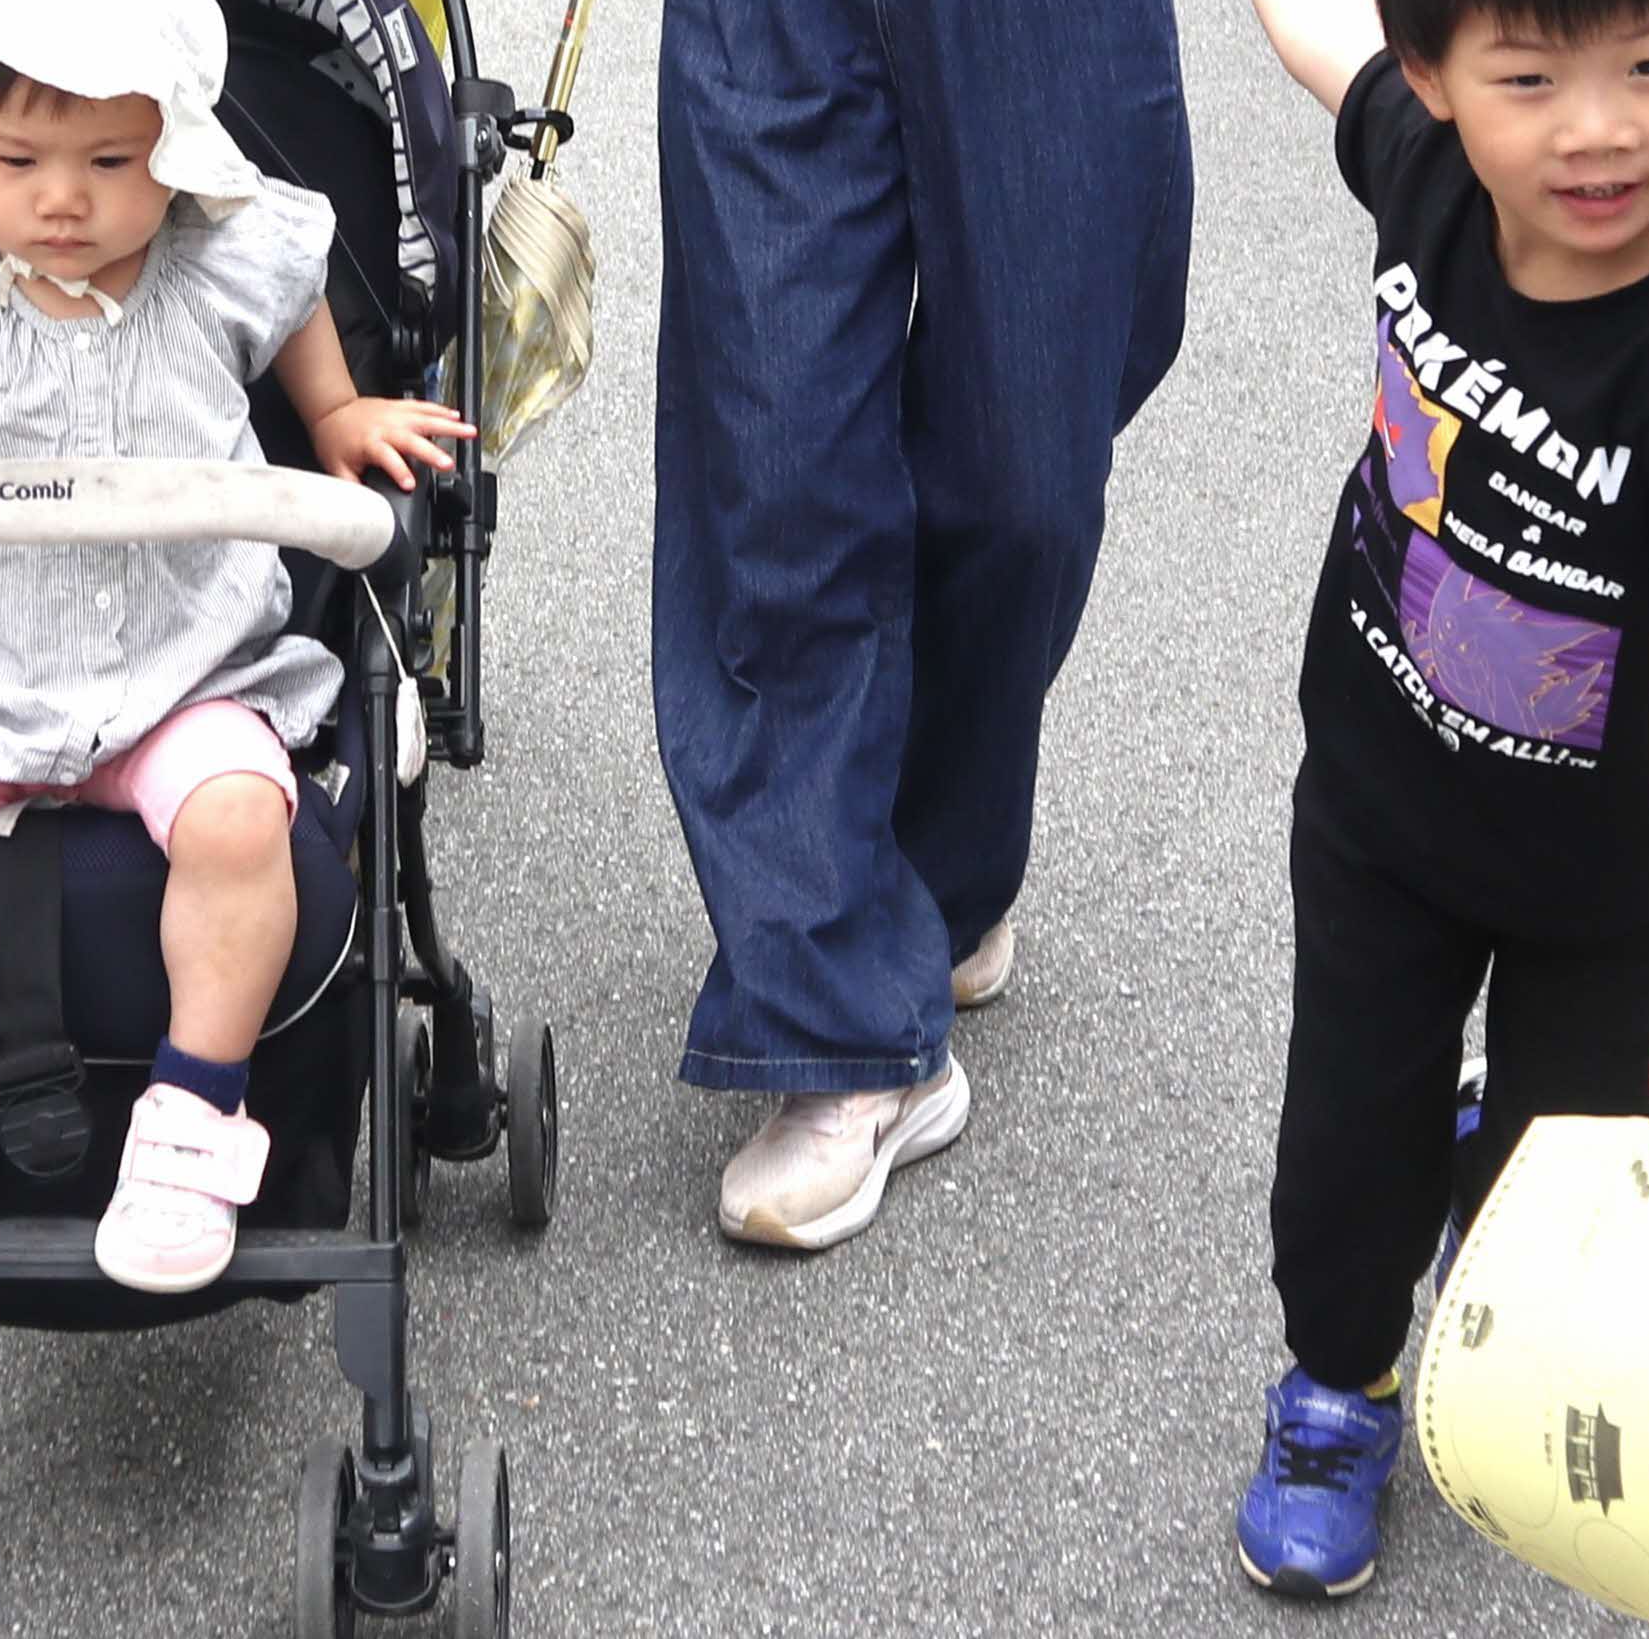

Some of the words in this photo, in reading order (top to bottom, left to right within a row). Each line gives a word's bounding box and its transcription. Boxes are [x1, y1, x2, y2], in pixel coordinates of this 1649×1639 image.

[1444, 510, 1504, 565] MEGA
[1521, 524, 1542, 545] &
[1366, 627, 1435, 710] CATCH
